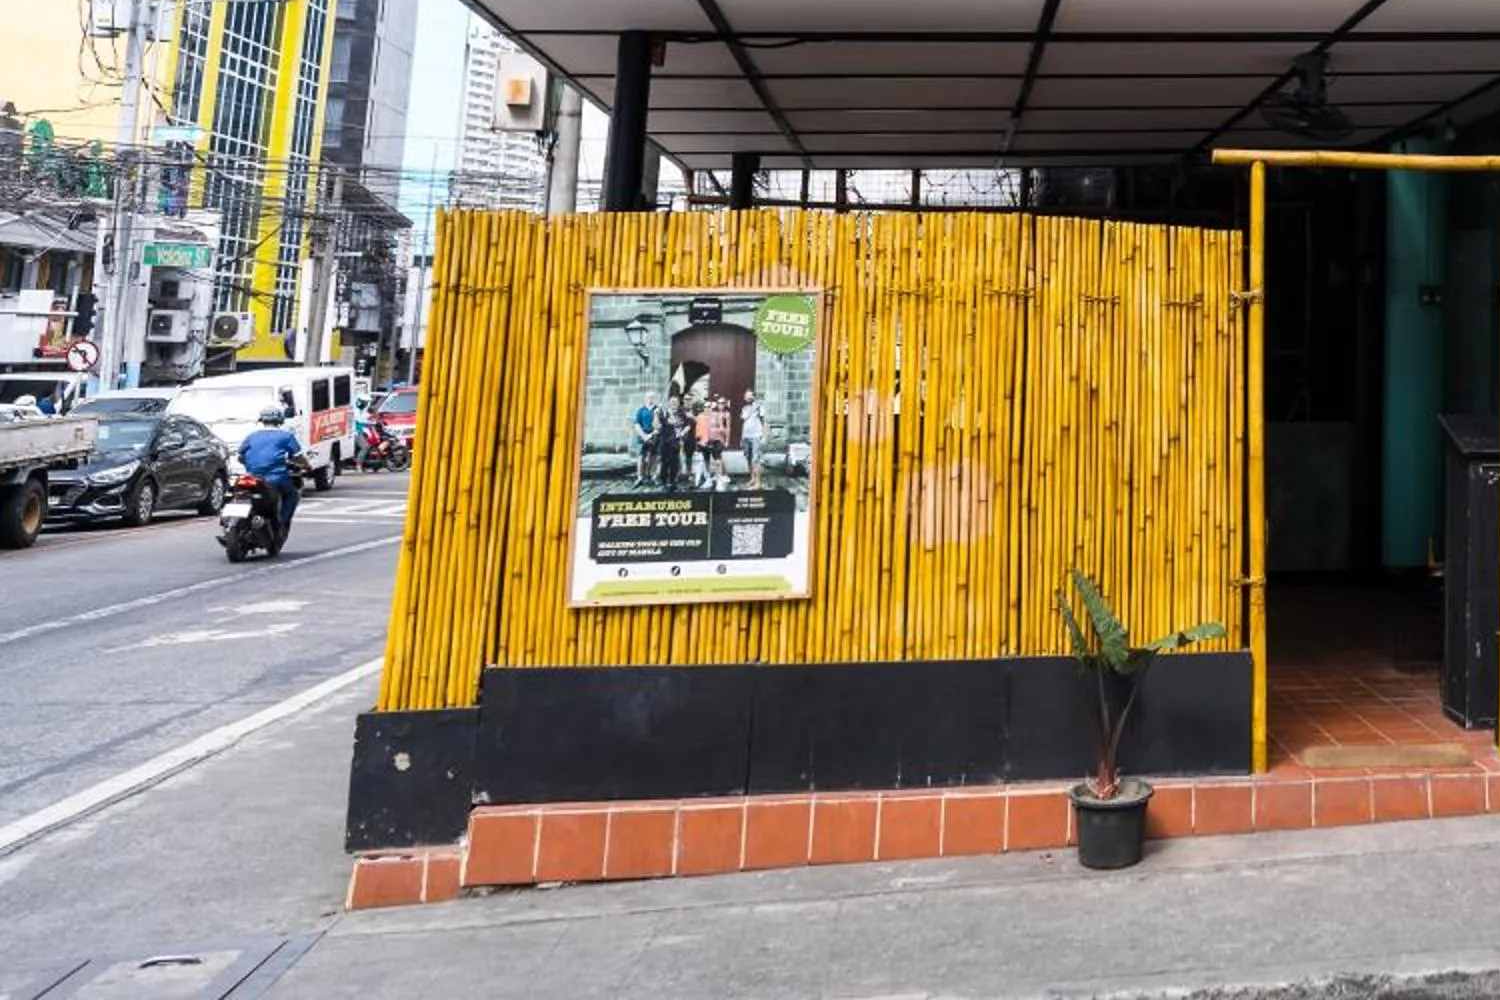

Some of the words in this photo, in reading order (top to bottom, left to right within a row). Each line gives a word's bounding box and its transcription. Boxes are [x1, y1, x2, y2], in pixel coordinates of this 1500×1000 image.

[766, 310, 810, 325] FREE
[762, 322, 809, 337] TOUR!
[598, 513, 652, 528] FREE
[655, 511, 709, 527] TOUR
